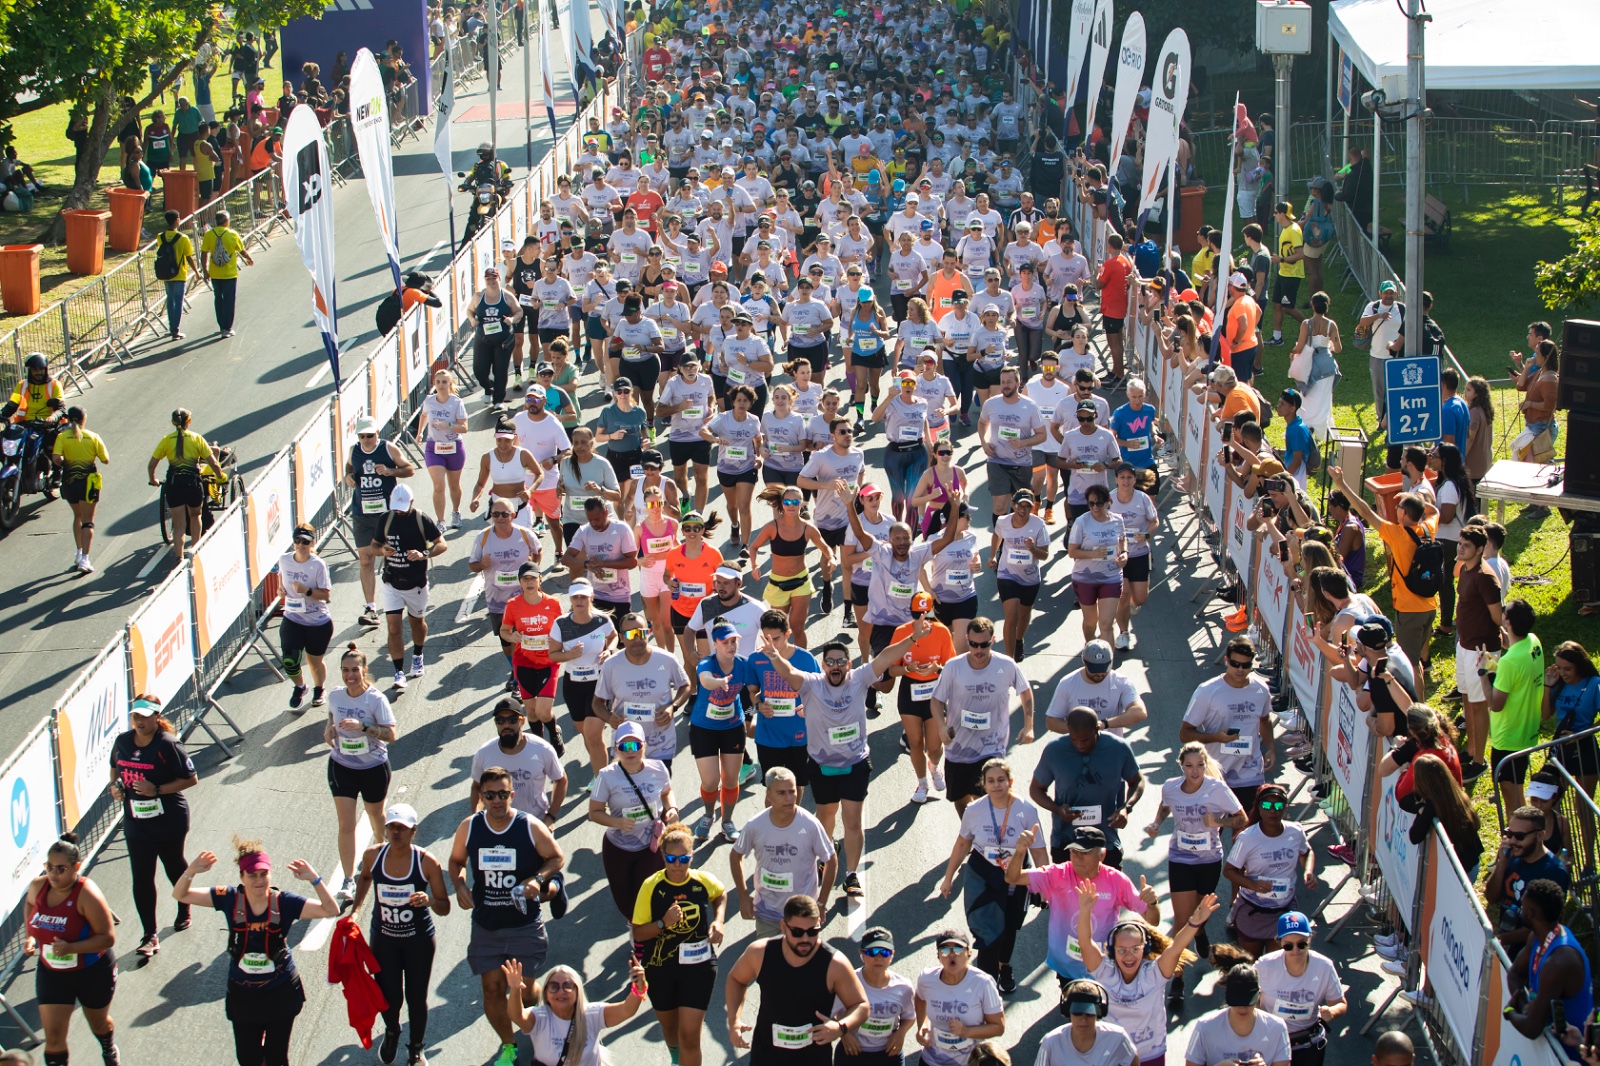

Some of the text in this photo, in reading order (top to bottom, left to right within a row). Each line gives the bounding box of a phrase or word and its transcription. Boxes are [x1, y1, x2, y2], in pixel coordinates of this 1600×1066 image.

[1400, 396, 1427, 410] km
[1400, 412, 1430, 436] 2,7
[360, 476, 383, 489] Rio
[154, 611, 185, 679] ESPN
[764, 690, 799, 698] RUNNERS
[485, 870, 517, 889] Rio
[39, 914, 68, 925] BETIM
[380, 905, 414, 924] Rio
[1286, 922, 1299, 930] RIO
[1442, 916, 1470, 992] minalba
